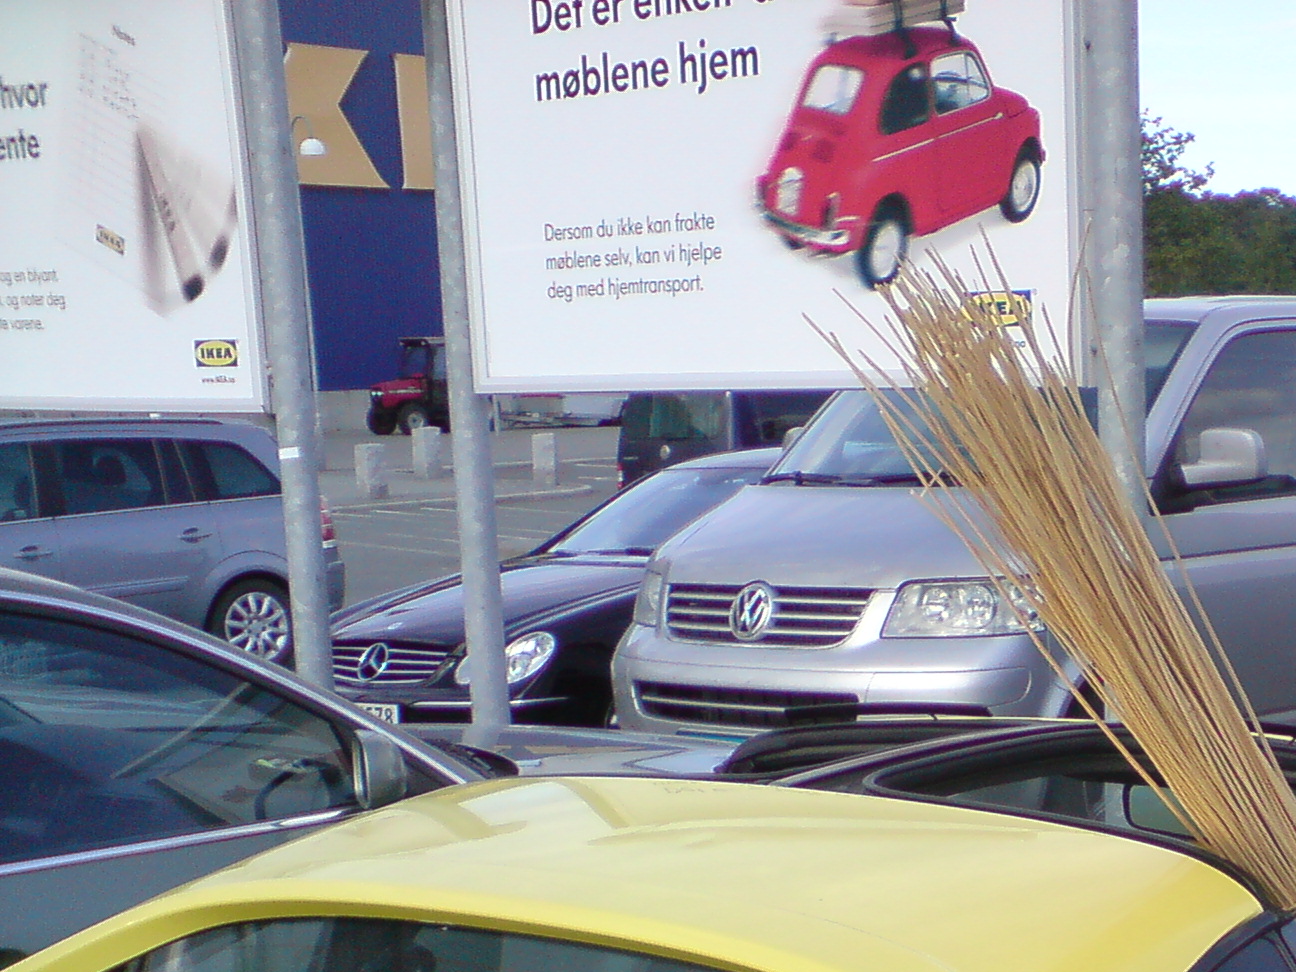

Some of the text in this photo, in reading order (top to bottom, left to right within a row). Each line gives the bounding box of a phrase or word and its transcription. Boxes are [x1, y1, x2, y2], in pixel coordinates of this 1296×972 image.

[532, 0, 582, 34] Det
[535, 38, 760, 101] møblene hjem
[544, 212, 715, 241] Dersom du ikke kan frakte
[546, 242, 722, 269] møblene selv, kan vi hjelpe
[547, 275, 704, 302] deg med hjemtransport.
[200, 347, 233, 359] IKEA
